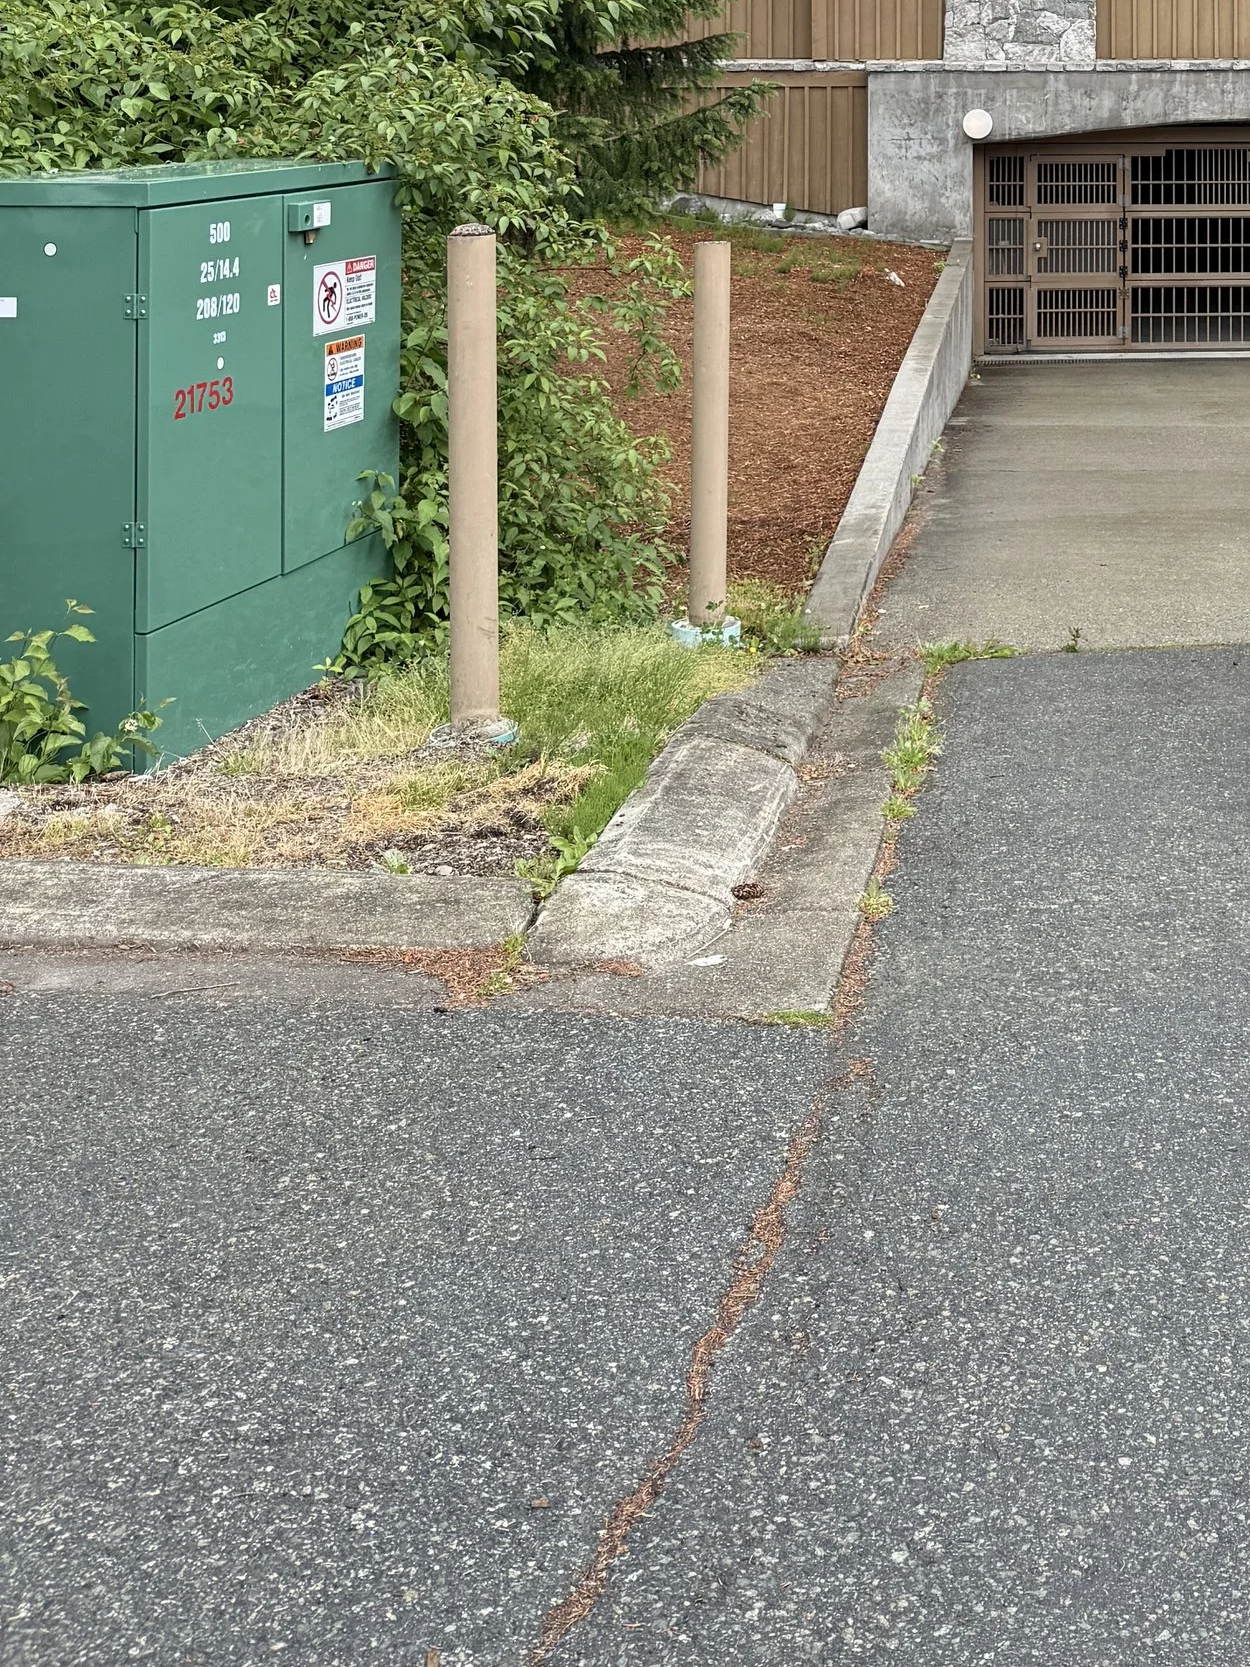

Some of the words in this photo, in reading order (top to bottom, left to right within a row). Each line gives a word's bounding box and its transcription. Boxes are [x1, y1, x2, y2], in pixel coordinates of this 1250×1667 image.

[209, 221, 231, 244] 500
[200, 256, 240, 283] 25/14.4
[352, 258, 375, 272] DANGER
[196, 292, 240, 320] 208/120
[336, 337, 362, 353] WARNING
[174, 376, 234, 420] 21753
[332, 378, 356, 395] NOTICE
